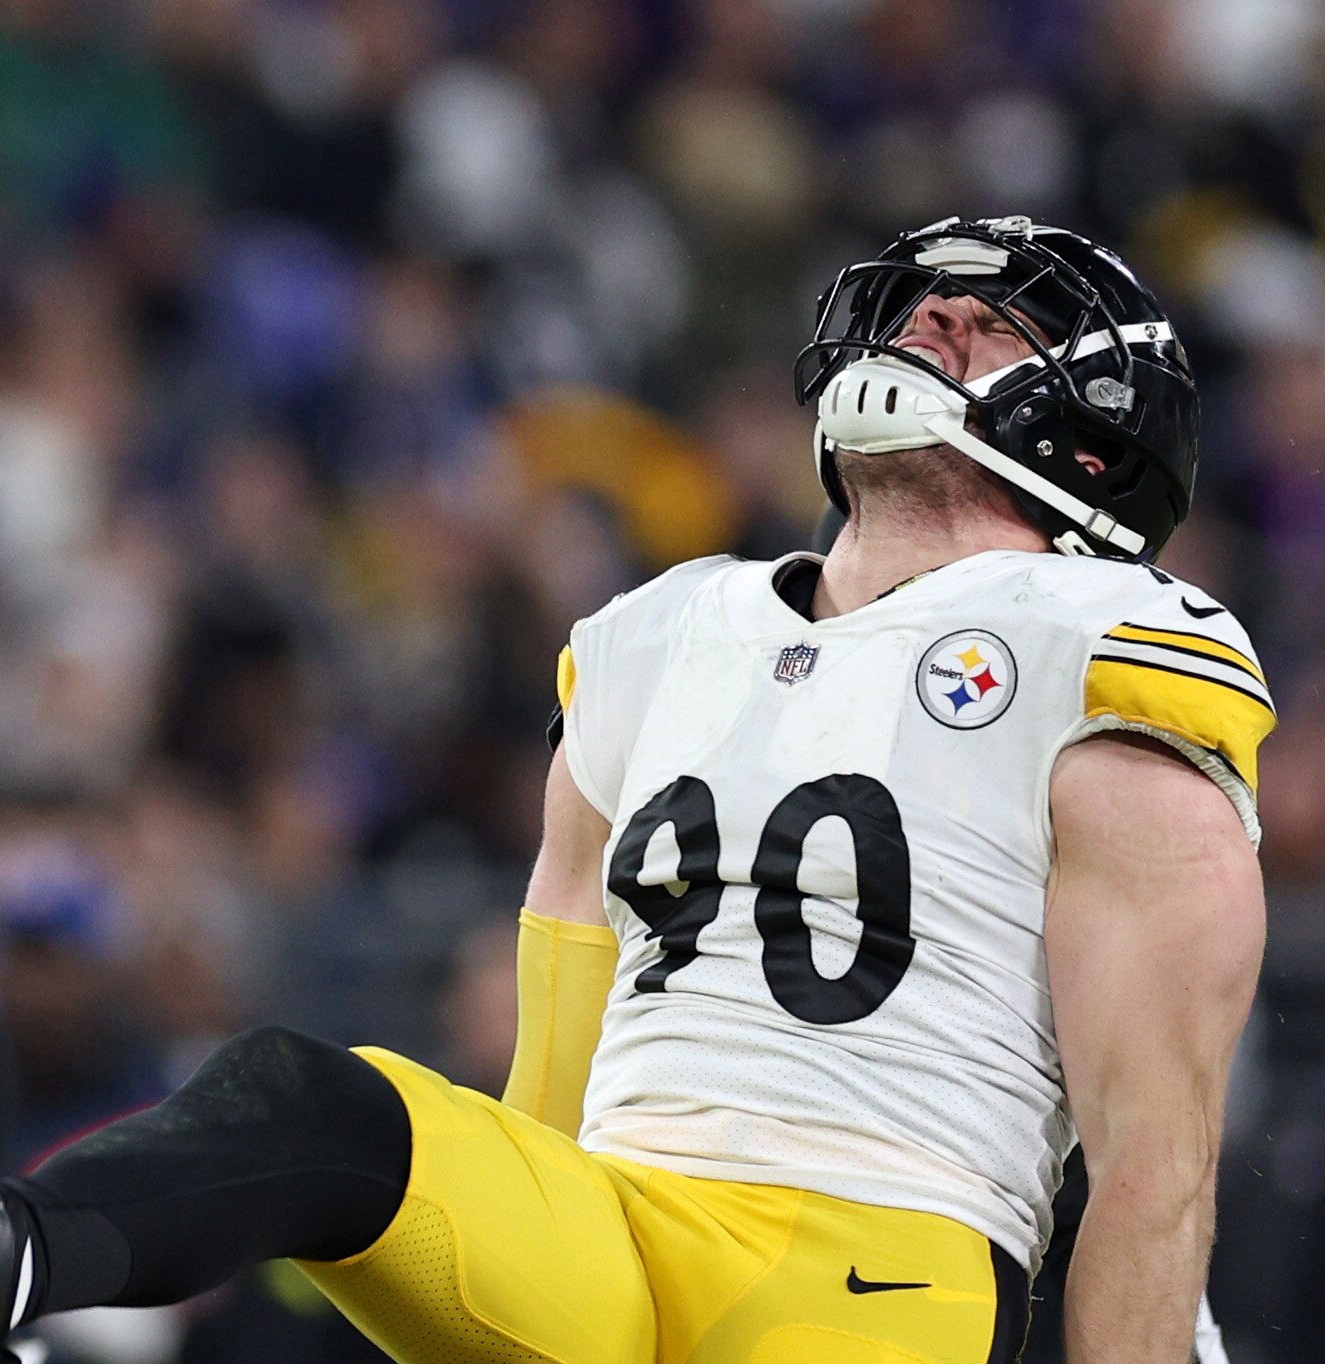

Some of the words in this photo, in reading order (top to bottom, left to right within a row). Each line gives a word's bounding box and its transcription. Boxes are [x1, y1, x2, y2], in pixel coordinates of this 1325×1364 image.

[779, 657, 809, 678] NFL
[928, 662, 965, 681] Steelers
[607, 773, 917, 1026] 90
